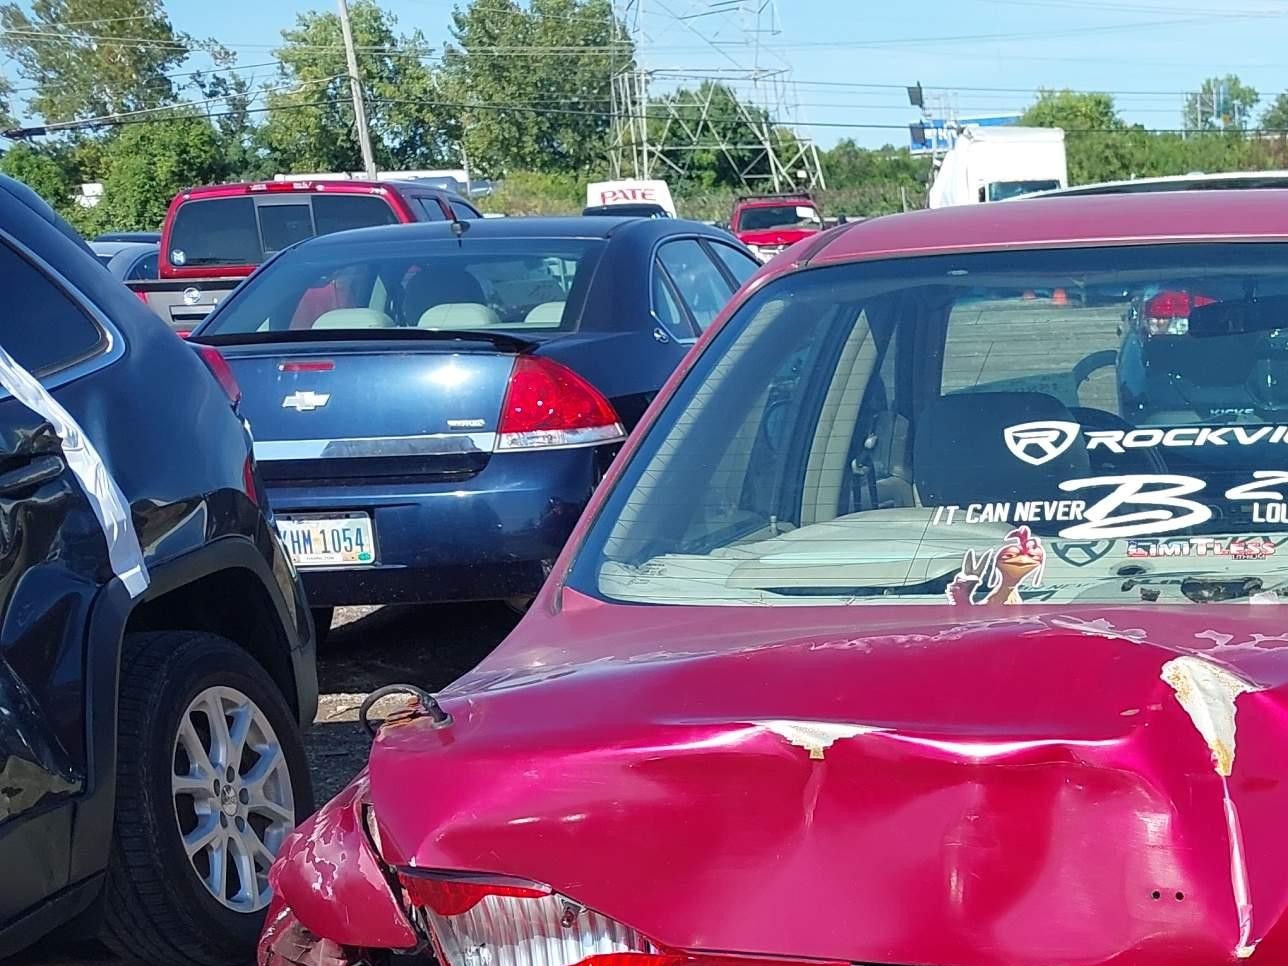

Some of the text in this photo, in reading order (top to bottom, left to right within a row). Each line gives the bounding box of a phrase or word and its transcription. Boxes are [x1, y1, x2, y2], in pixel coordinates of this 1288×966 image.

[600, 187, 657, 206] PATE
[932, 505, 960, 526] IT
[965, 501, 1010, 525] CAN
[1013, 499, 1086, 522] NEVER
[1058, 474, 1212, 540] B
[319, 527, 365, 554] 1054
[1127, 538, 1276, 558] LIMITLESS
